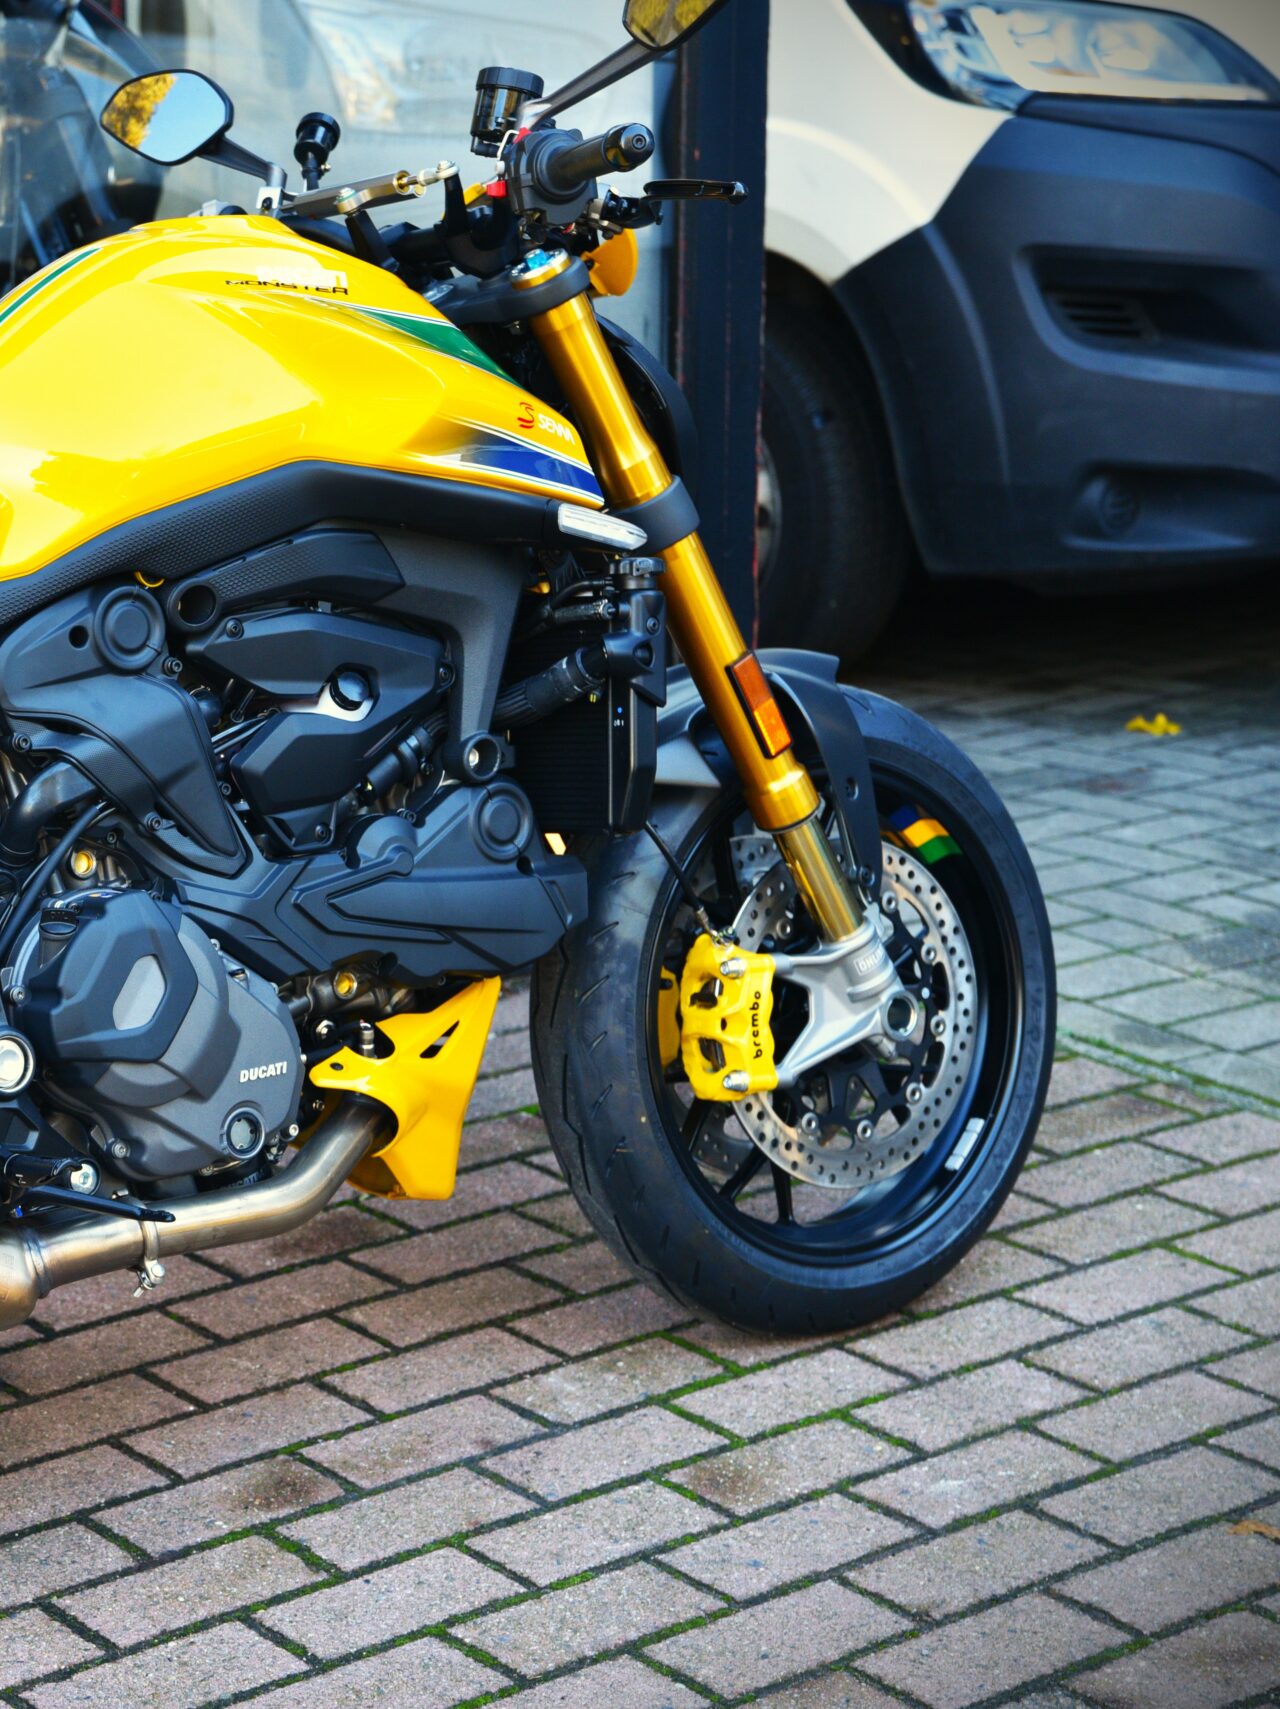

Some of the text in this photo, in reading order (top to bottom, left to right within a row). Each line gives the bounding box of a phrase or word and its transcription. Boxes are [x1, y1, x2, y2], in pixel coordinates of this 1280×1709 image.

[537, 413, 576, 446] SENNA
[749, 991, 763, 1059] brembo
[239, 1060, 288, 1083] DUCATI
